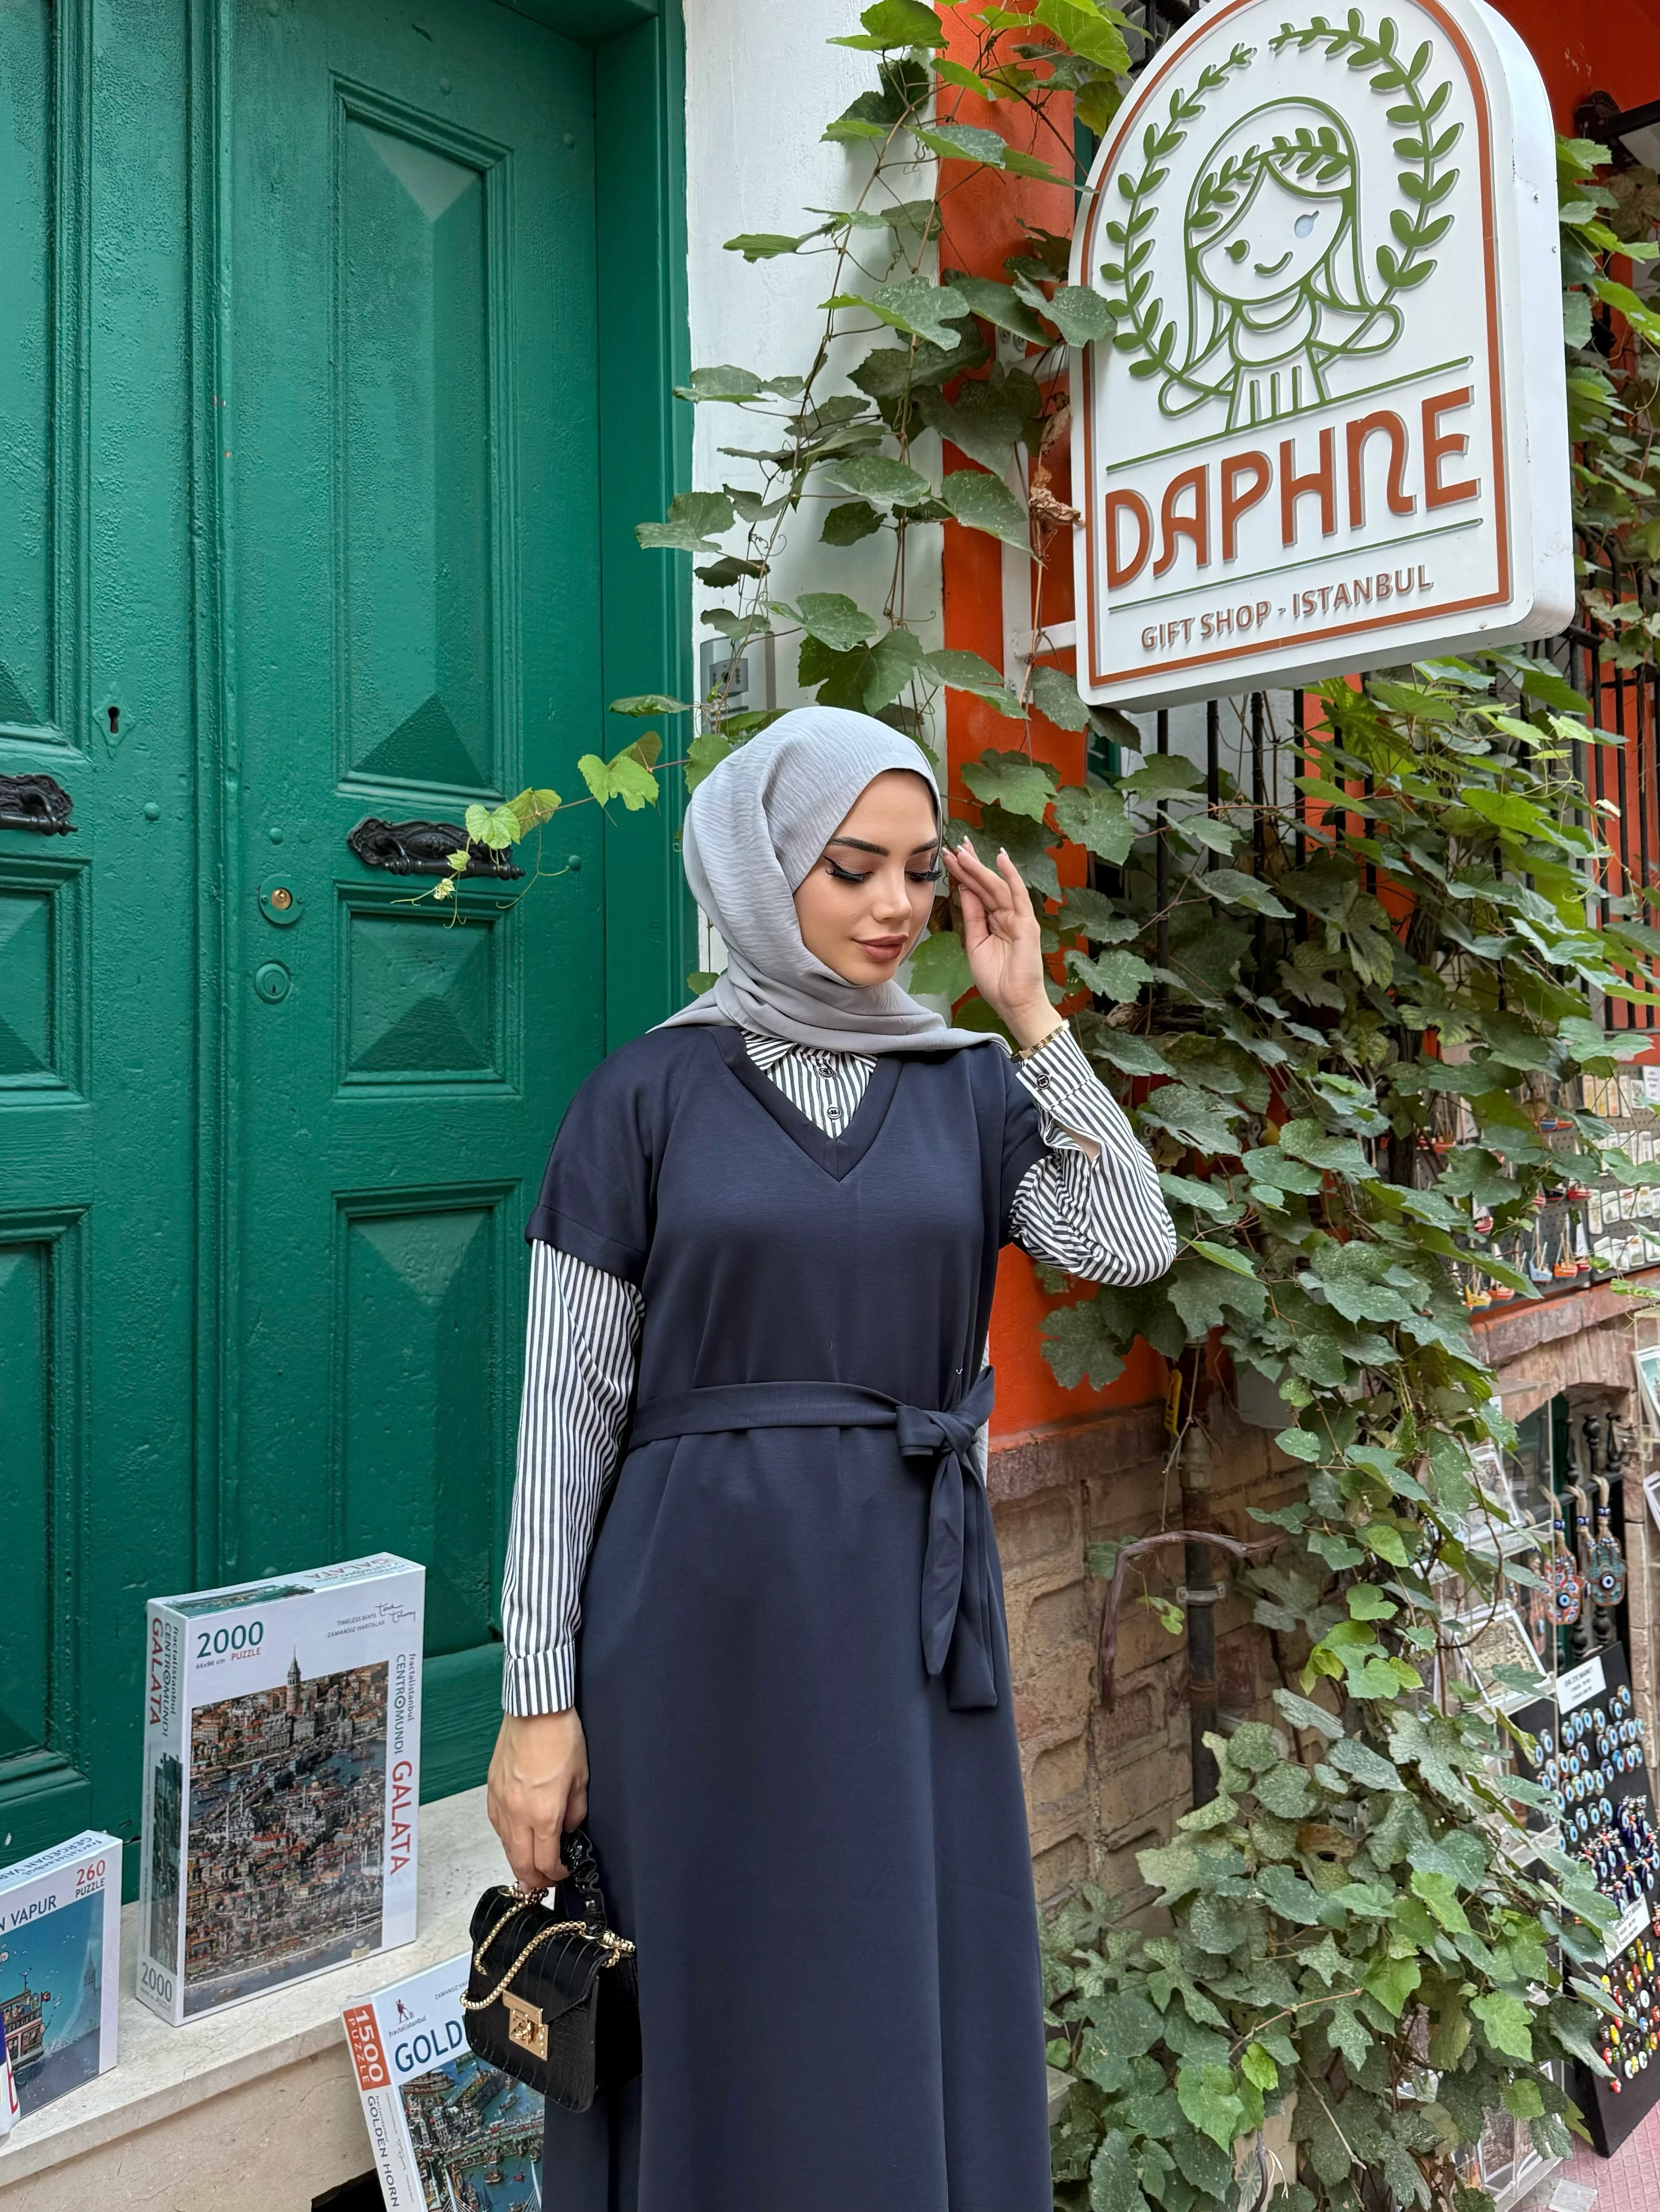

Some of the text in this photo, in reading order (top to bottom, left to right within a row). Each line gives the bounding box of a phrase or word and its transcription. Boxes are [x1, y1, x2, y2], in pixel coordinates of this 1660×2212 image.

[1106, 385, 1482, 591] DAPHNE
[1141, 617, 1195, 650] GIFT
[1201, 600, 1271, 638] SHOP
[1293, 564, 1433, 617] ISTANBUL
[197, 1621, 264, 1658] 2000
[327, 1627, 356, 1638] ZAMANSIZ
[337, 1616, 361, 1626] TIMELESS
[150, 1617, 164, 1725] GALATA
[162, 1622, 172, 1737] CENTROMUNDI
[231, 1647, 262, 1661] PUZZLE
[394, 1653, 406, 1754] CENTROMUNDI
[408, 1653, 417, 1722] fractalistanbul
[390, 1760, 413, 1875] GALATA
[0, 1837, 93, 1881] GERGEDAN VAP
[75, 1877, 106, 1898] PUZZLE
[76, 1859, 106, 1887] 260
[11, 1895, 57, 1926] VAPUR
[141, 1962, 172, 2002] 2000
[348, 2018, 370, 2084] PUZZLE
[356, 2009, 384, 2082] 1500
[388, 2015, 428, 2038] fractalistanbul
[395, 2015, 466, 2072] GOLD
[367, 2096, 400, 2207] GOLDEN HORN
